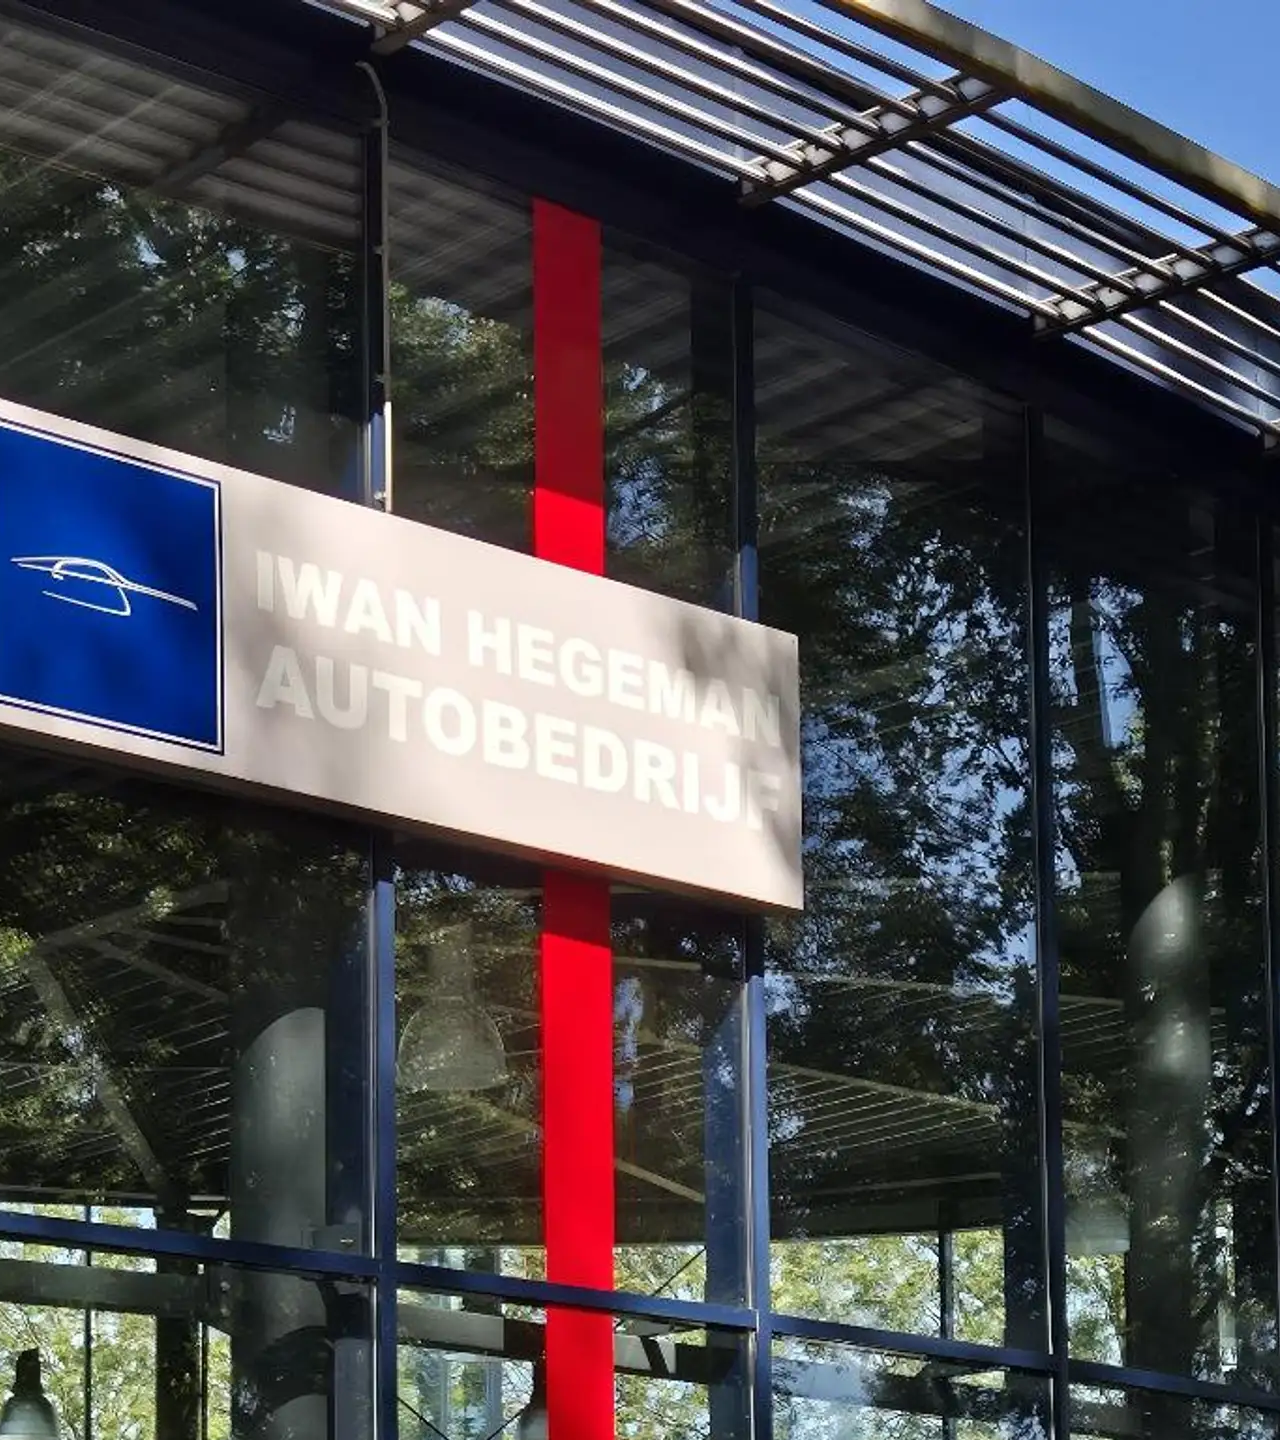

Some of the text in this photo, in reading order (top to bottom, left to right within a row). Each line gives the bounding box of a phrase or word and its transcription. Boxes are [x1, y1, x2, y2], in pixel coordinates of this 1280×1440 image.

[255, 549, 782, 749] IWAN HEGEMAN
[255, 645, 782, 831] AUTOBEDRIJF
